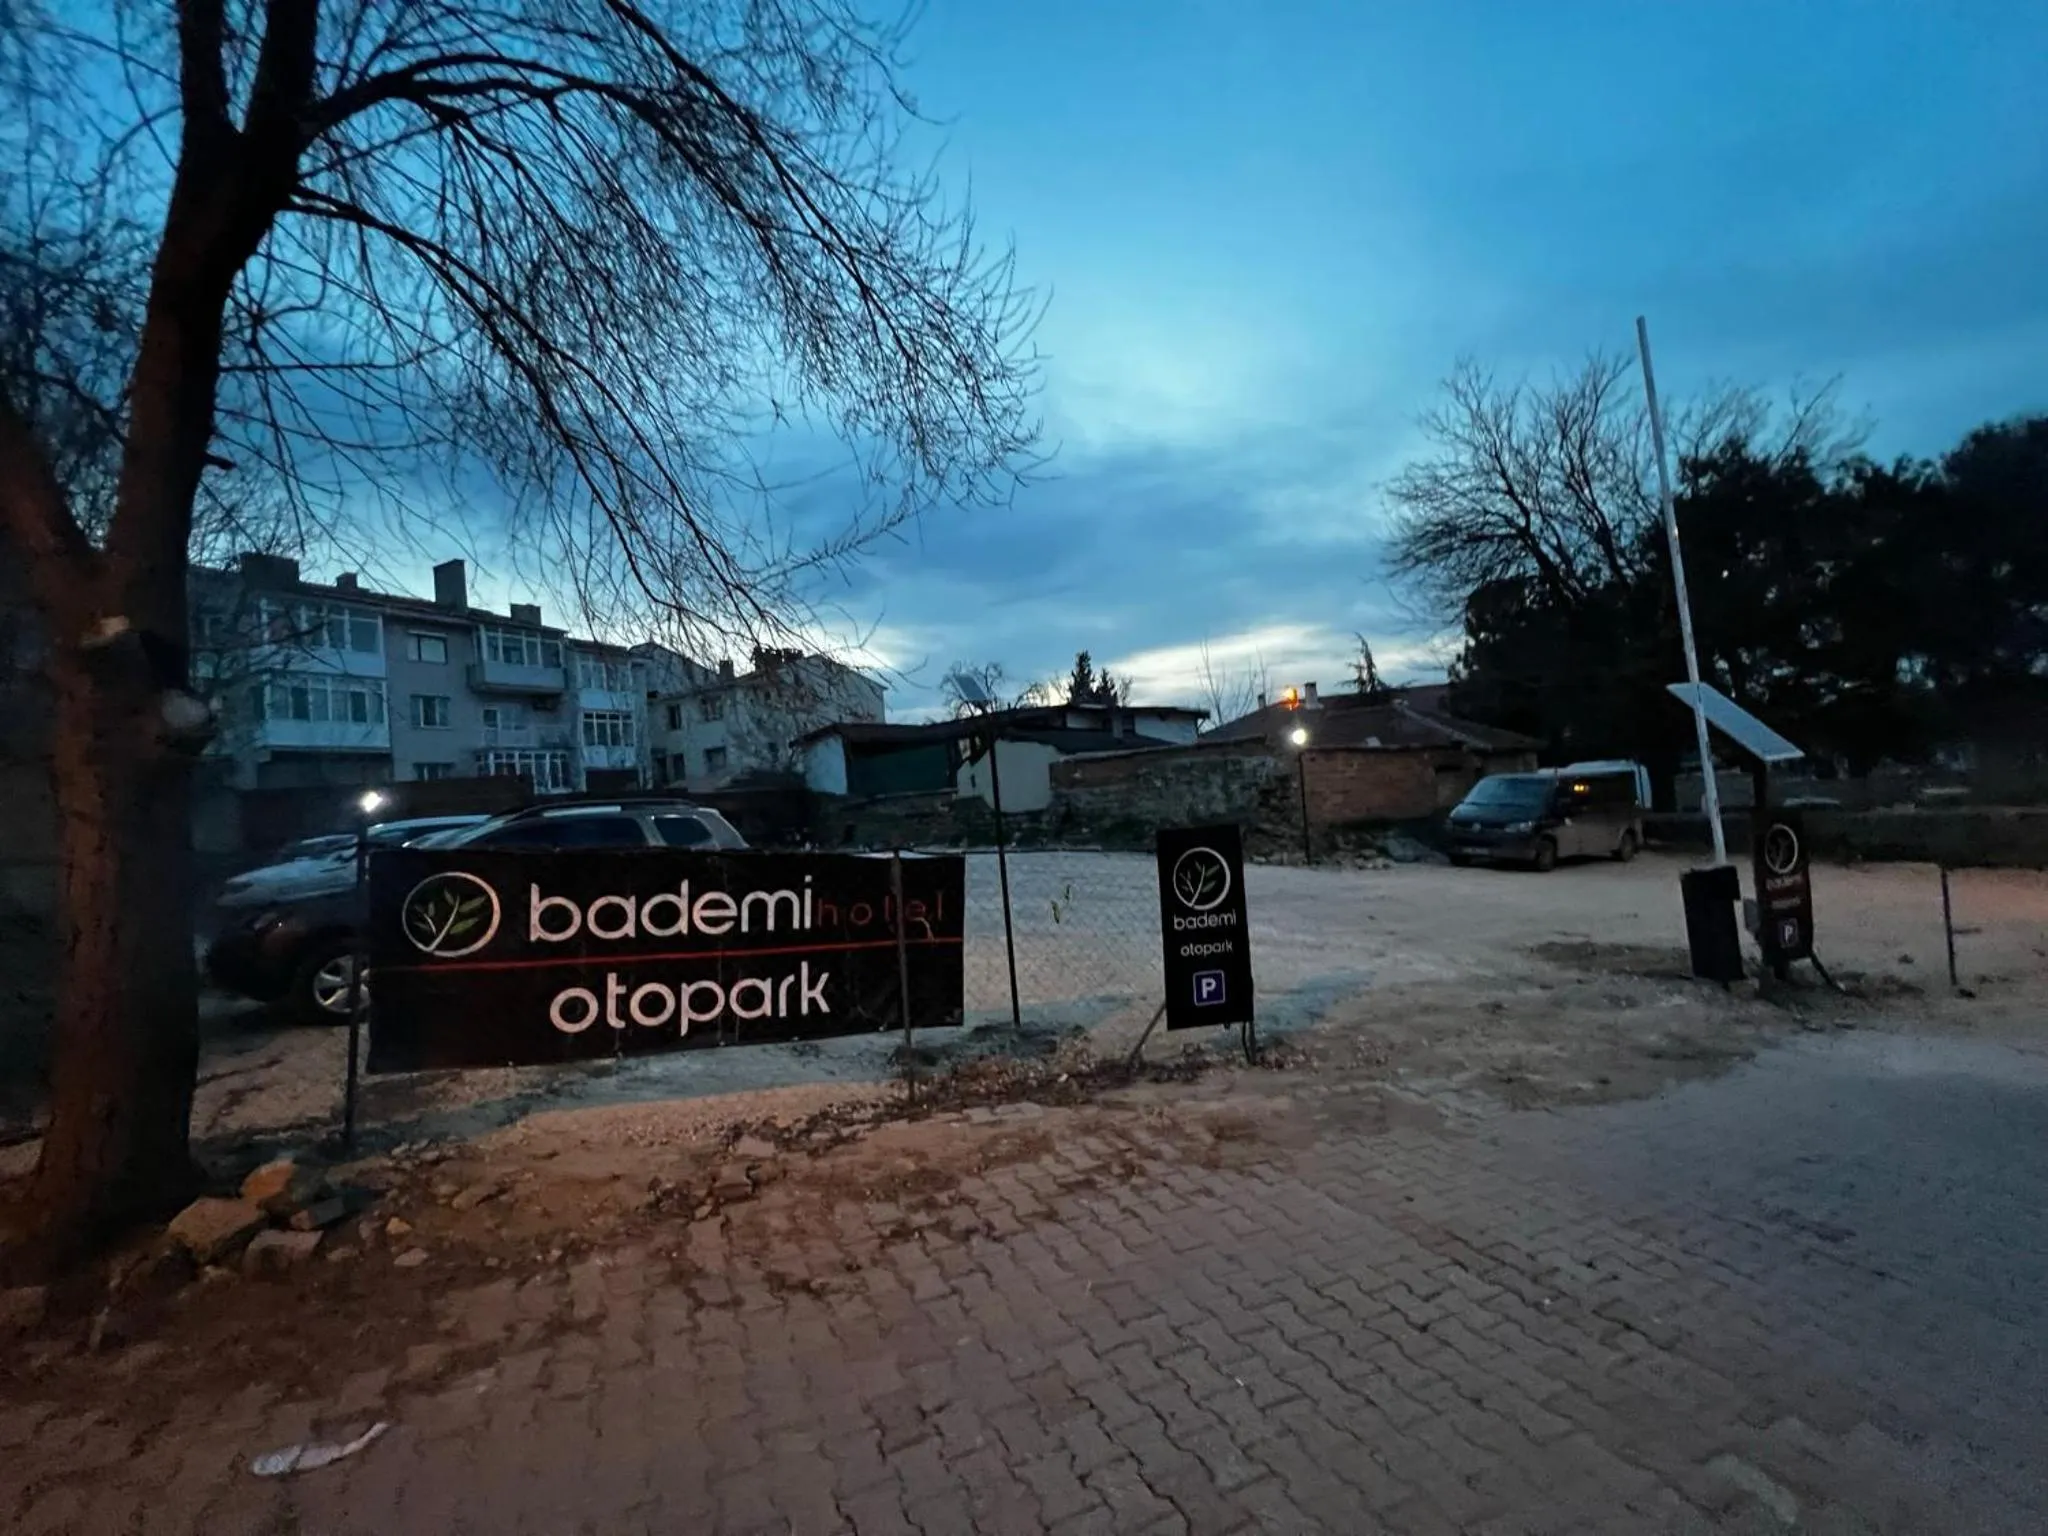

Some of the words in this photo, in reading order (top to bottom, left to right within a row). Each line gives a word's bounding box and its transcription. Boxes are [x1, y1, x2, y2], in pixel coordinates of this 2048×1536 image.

[529, 874, 813, 943] bademi
[1173, 909, 1237, 931] bademi
[1783, 924, 1794, 942] P
[1180, 940, 1234, 957] otopark
[549, 961, 831, 1036] otopark
[1201, 978, 1217, 999] P
